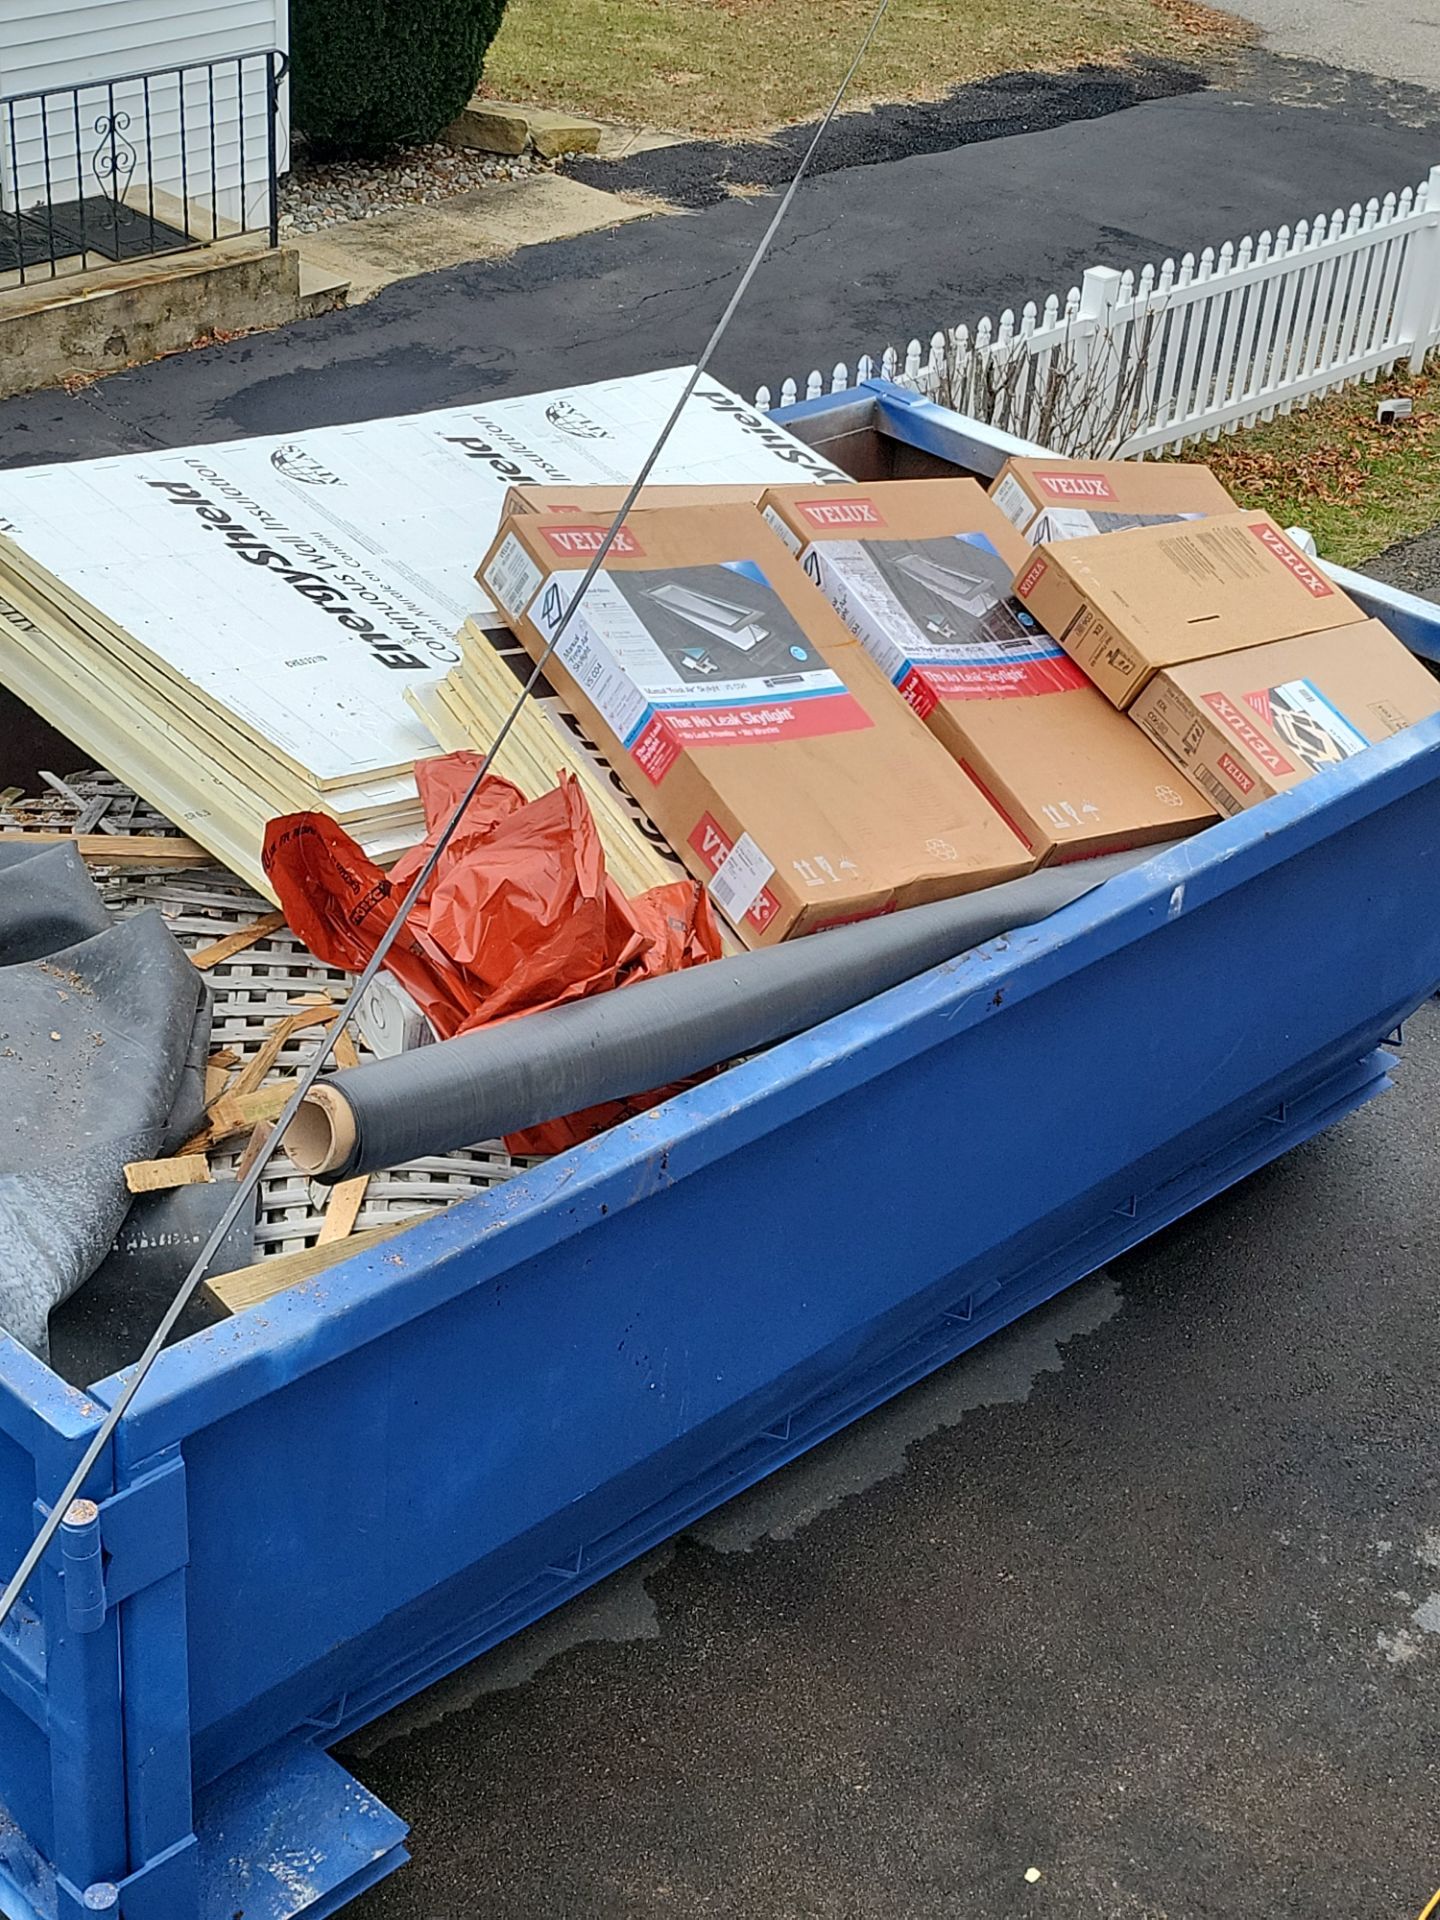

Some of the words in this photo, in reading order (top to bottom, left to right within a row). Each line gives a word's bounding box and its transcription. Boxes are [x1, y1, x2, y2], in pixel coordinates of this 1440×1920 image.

[283, 444, 348, 487] ATLAS
[472, 415, 572, 482] Insulation
[184, 458, 290, 531] Insulation
[1042, 478, 1110, 497] VELUX
[806, 505, 878, 523] VELUX
[275, 534, 338, 570] Wall
[1261, 529, 1324, 592] VELUX
[145, 480, 431, 670] EnergyShield
[1020, 563, 1045, 595] VELUX
[333, 573, 461, 664] Continuous
[665, 715, 691, 729] The
[692, 714, 711, 728] No
[711, 712, 743, 727] Leak
[740, 707, 796, 727] Skylight
[1213, 699, 1281, 770] VELUX
[1222, 756, 1251, 791] VELUX
